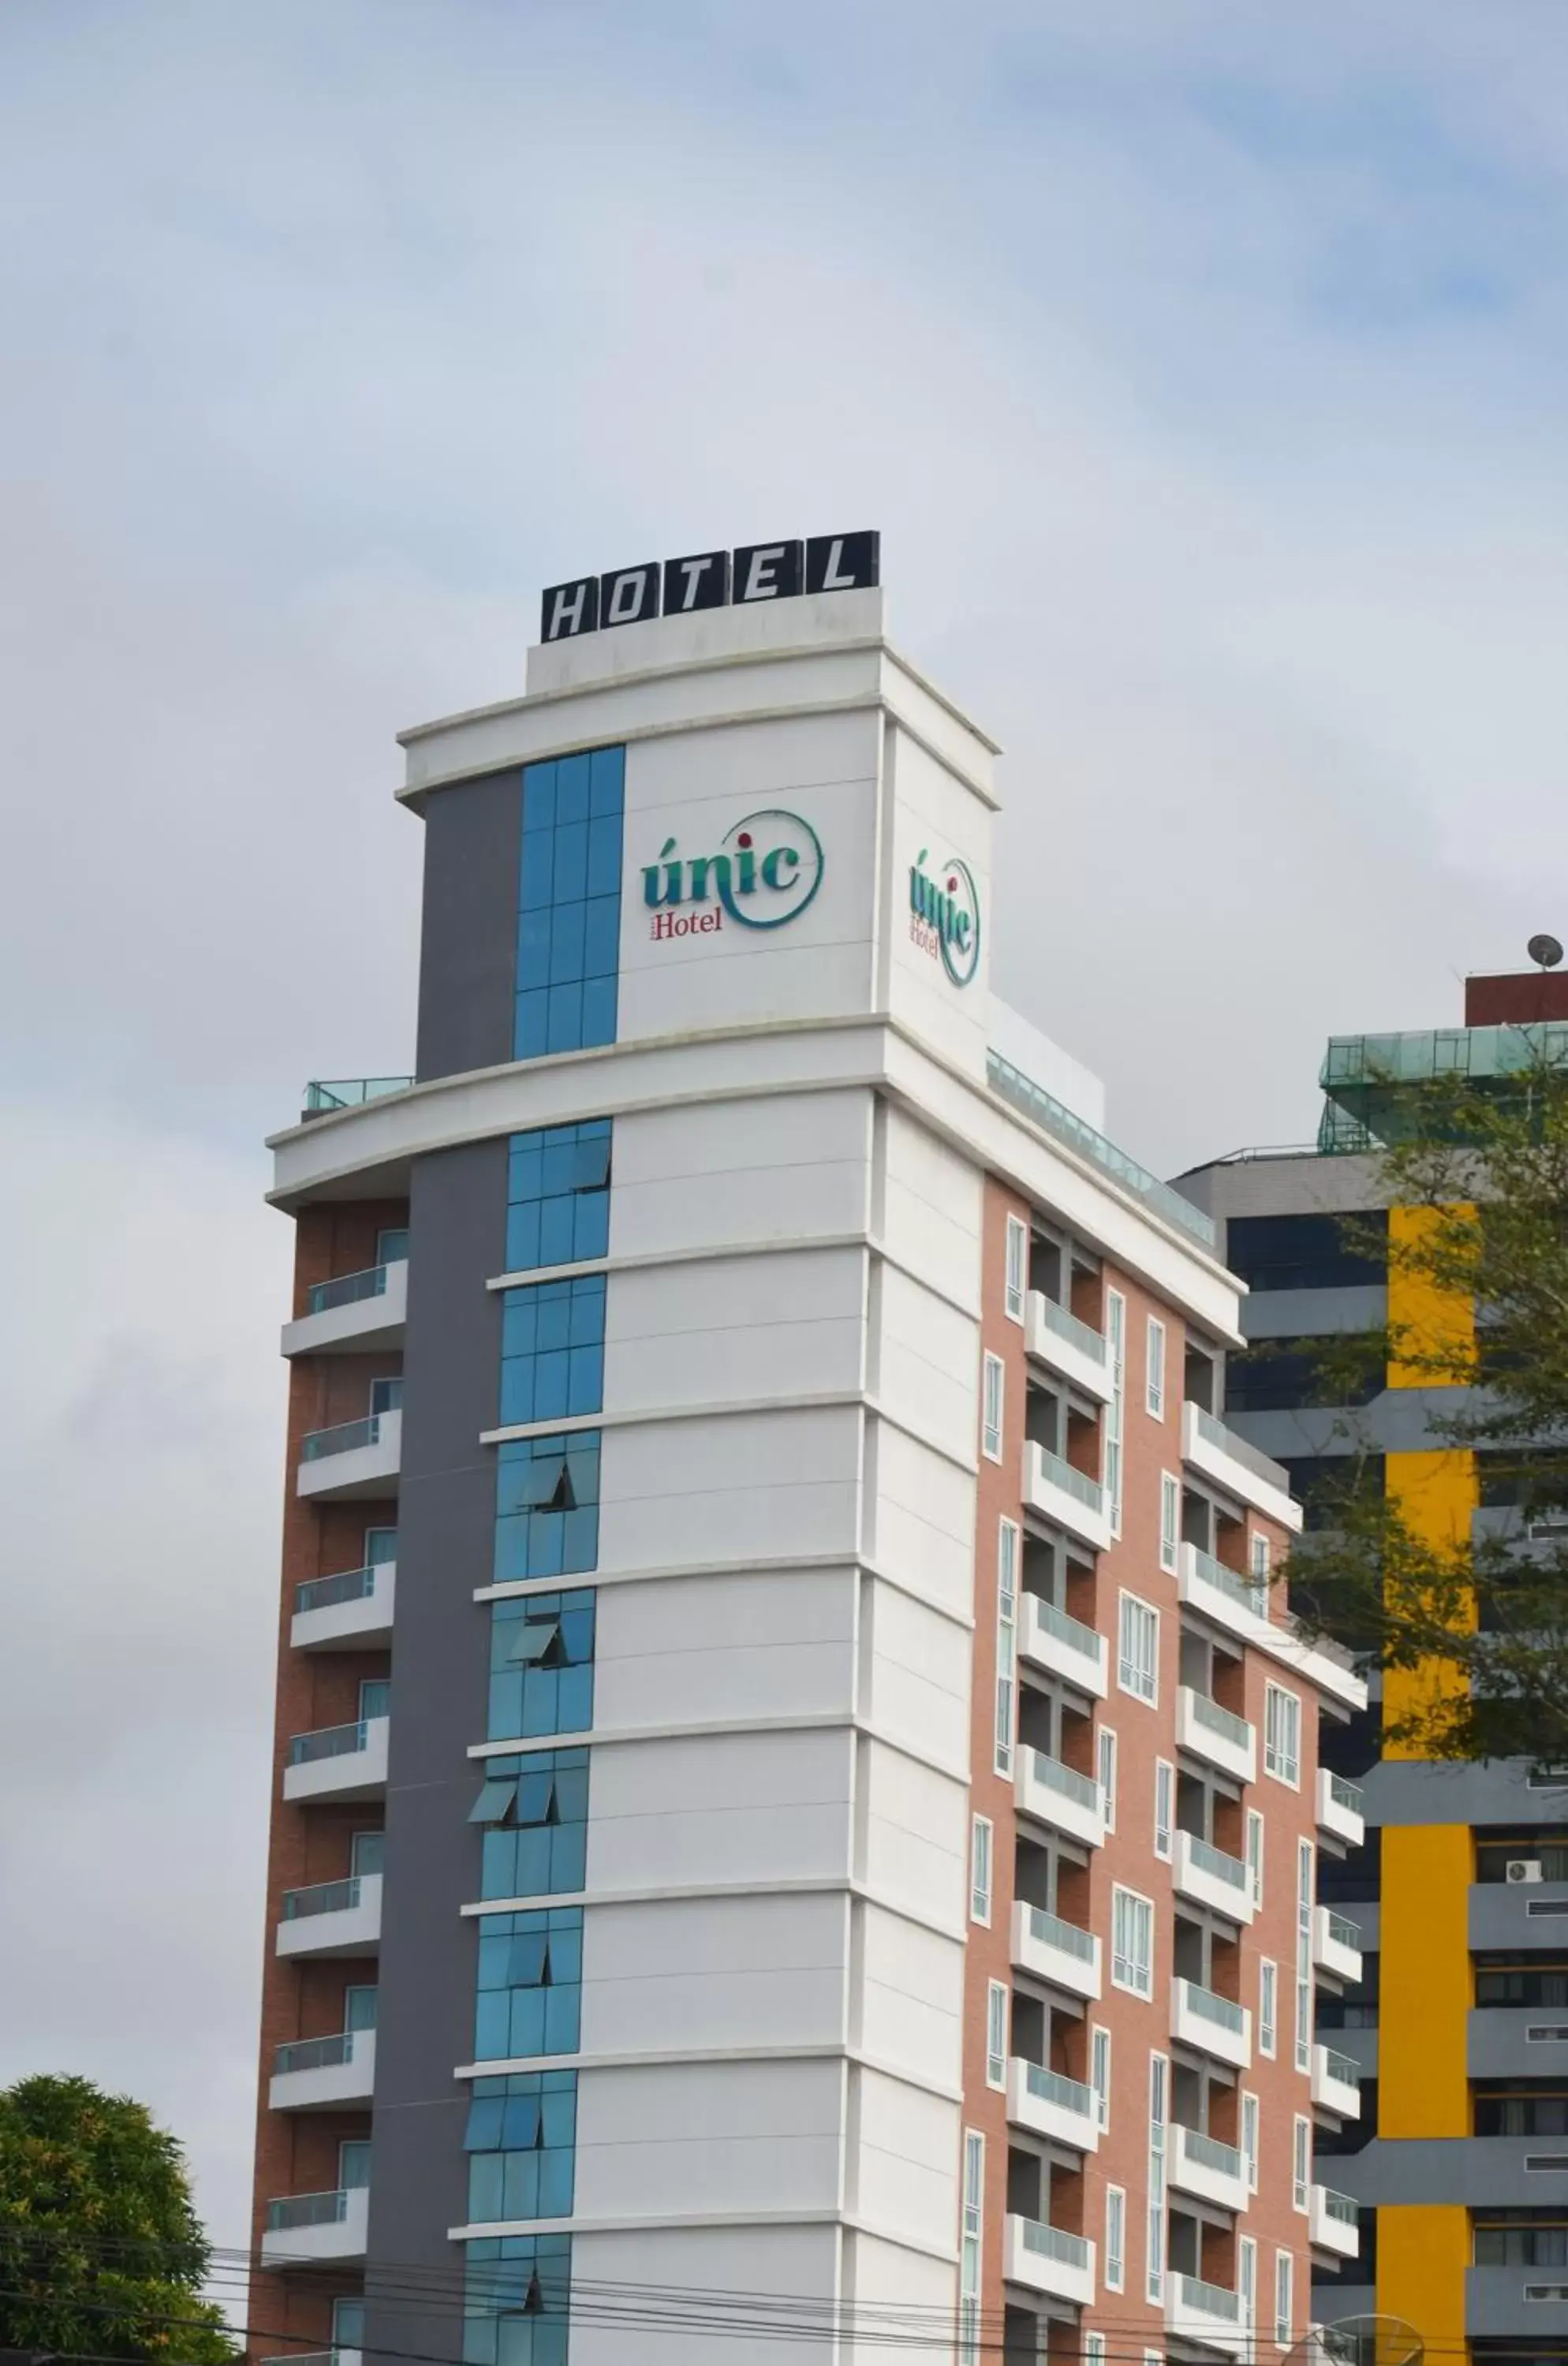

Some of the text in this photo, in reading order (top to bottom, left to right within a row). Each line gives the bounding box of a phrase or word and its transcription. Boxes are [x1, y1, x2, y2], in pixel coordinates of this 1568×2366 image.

[548, 539, 856, 640] HOTEL
[640, 809, 823, 929] únic
[909, 848, 980, 990] únic
[655, 906, 723, 941] Hotel
[909, 919, 938, 961] Hotel
